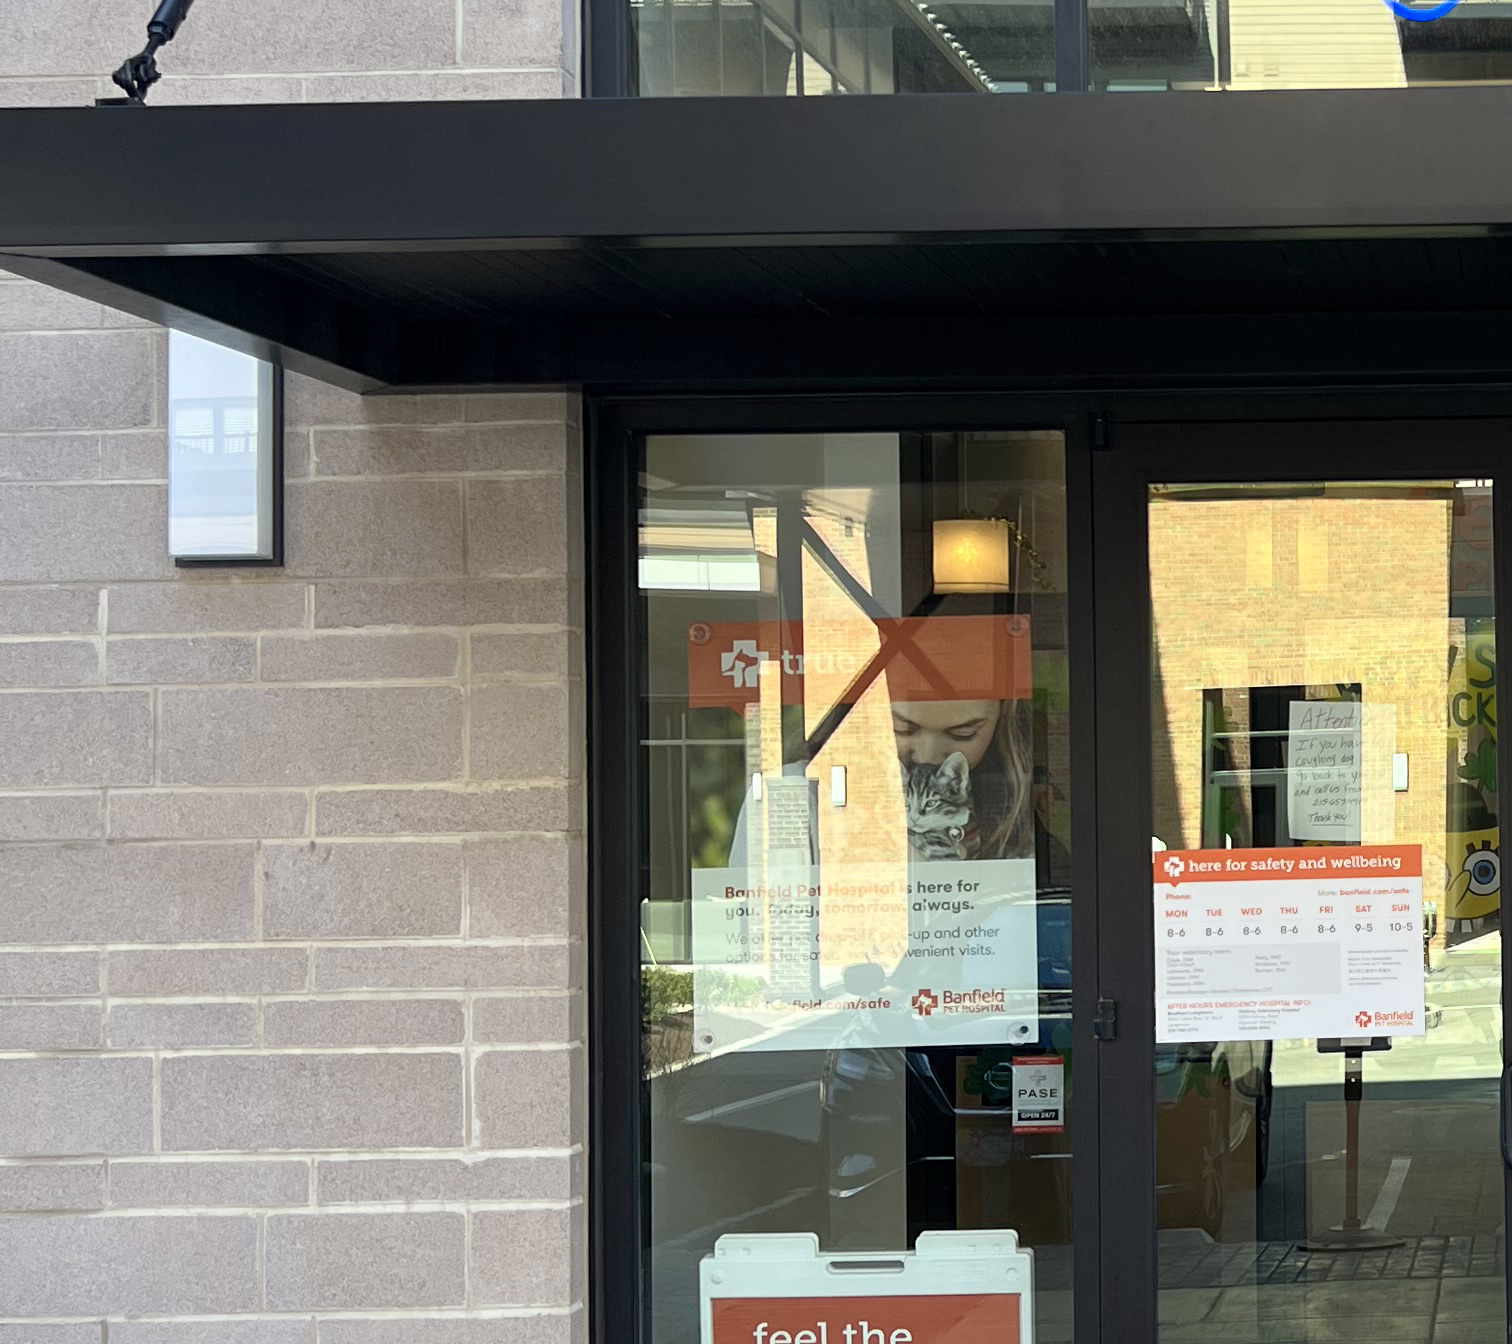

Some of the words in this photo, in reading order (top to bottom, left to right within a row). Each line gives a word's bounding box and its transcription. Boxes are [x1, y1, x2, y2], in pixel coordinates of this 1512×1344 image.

[1295, 737, 1317, 751] If
[1319, 740, 1337, 753] you
[1295, 752, 1336, 768] coughing
[1337, 770, 1346, 780] to
[1294, 785, 1310, 797] and
[1307, 811, 1331, 823] Thank
[1188, 860, 1222, 872] here
[1226, 859, 1247, 871] for
[1250, 858, 1295, 873] safety
[1298, 857, 1327, 870] and
[1330, 855, 1402, 871] wellbeing
[725, 885, 791, 900] Banfield
[797, 884, 822, 897] Pet
[827, 882, 895, 899] Hospital
[899, 882, 912, 894] is
[917, 882, 953, 893] here
[957, 880, 979, 893] for
[725, 906, 760, 921] you.
[912, 898, 975, 912] always.
[1165, 909, 1188, 918] MON
[1205, 908, 1223, 917] TUE
[1240, 907, 1263, 916] WED
[1280, 906, 1298, 915] THU
[1319, 905, 1333, 914] FRI
[1355, 904, 1372, 913] SAT
[1391, 904, 1410, 912] SUN
[727, 933, 748, 945] We
[934, 927, 960, 939] and
[963, 926, 1000, 938] other
[1167, 928, 1186, 938] 8-6
[1205, 927, 1224, 936] 8-6
[1243, 926, 1261, 936] 8-6
[1280, 925, 1299, 934] 8-6
[1317, 924, 1336, 934] 8-6
[1354, 923, 1374, 933] 9-5
[1389, 922, 1413, 932] 10-5
[959, 944, 996, 956] visits.
[943, 989, 1006, 1003] Banfield
[943, 1005, 959, 1013] PET
[961, 1004, 1006, 1013] HOSPITAL
[1259, 1000, 1291, 1008] HOSPITAL
[1375, 1011, 1414, 1020] Banfield
[1018, 1088, 1058, 1098] PASE
